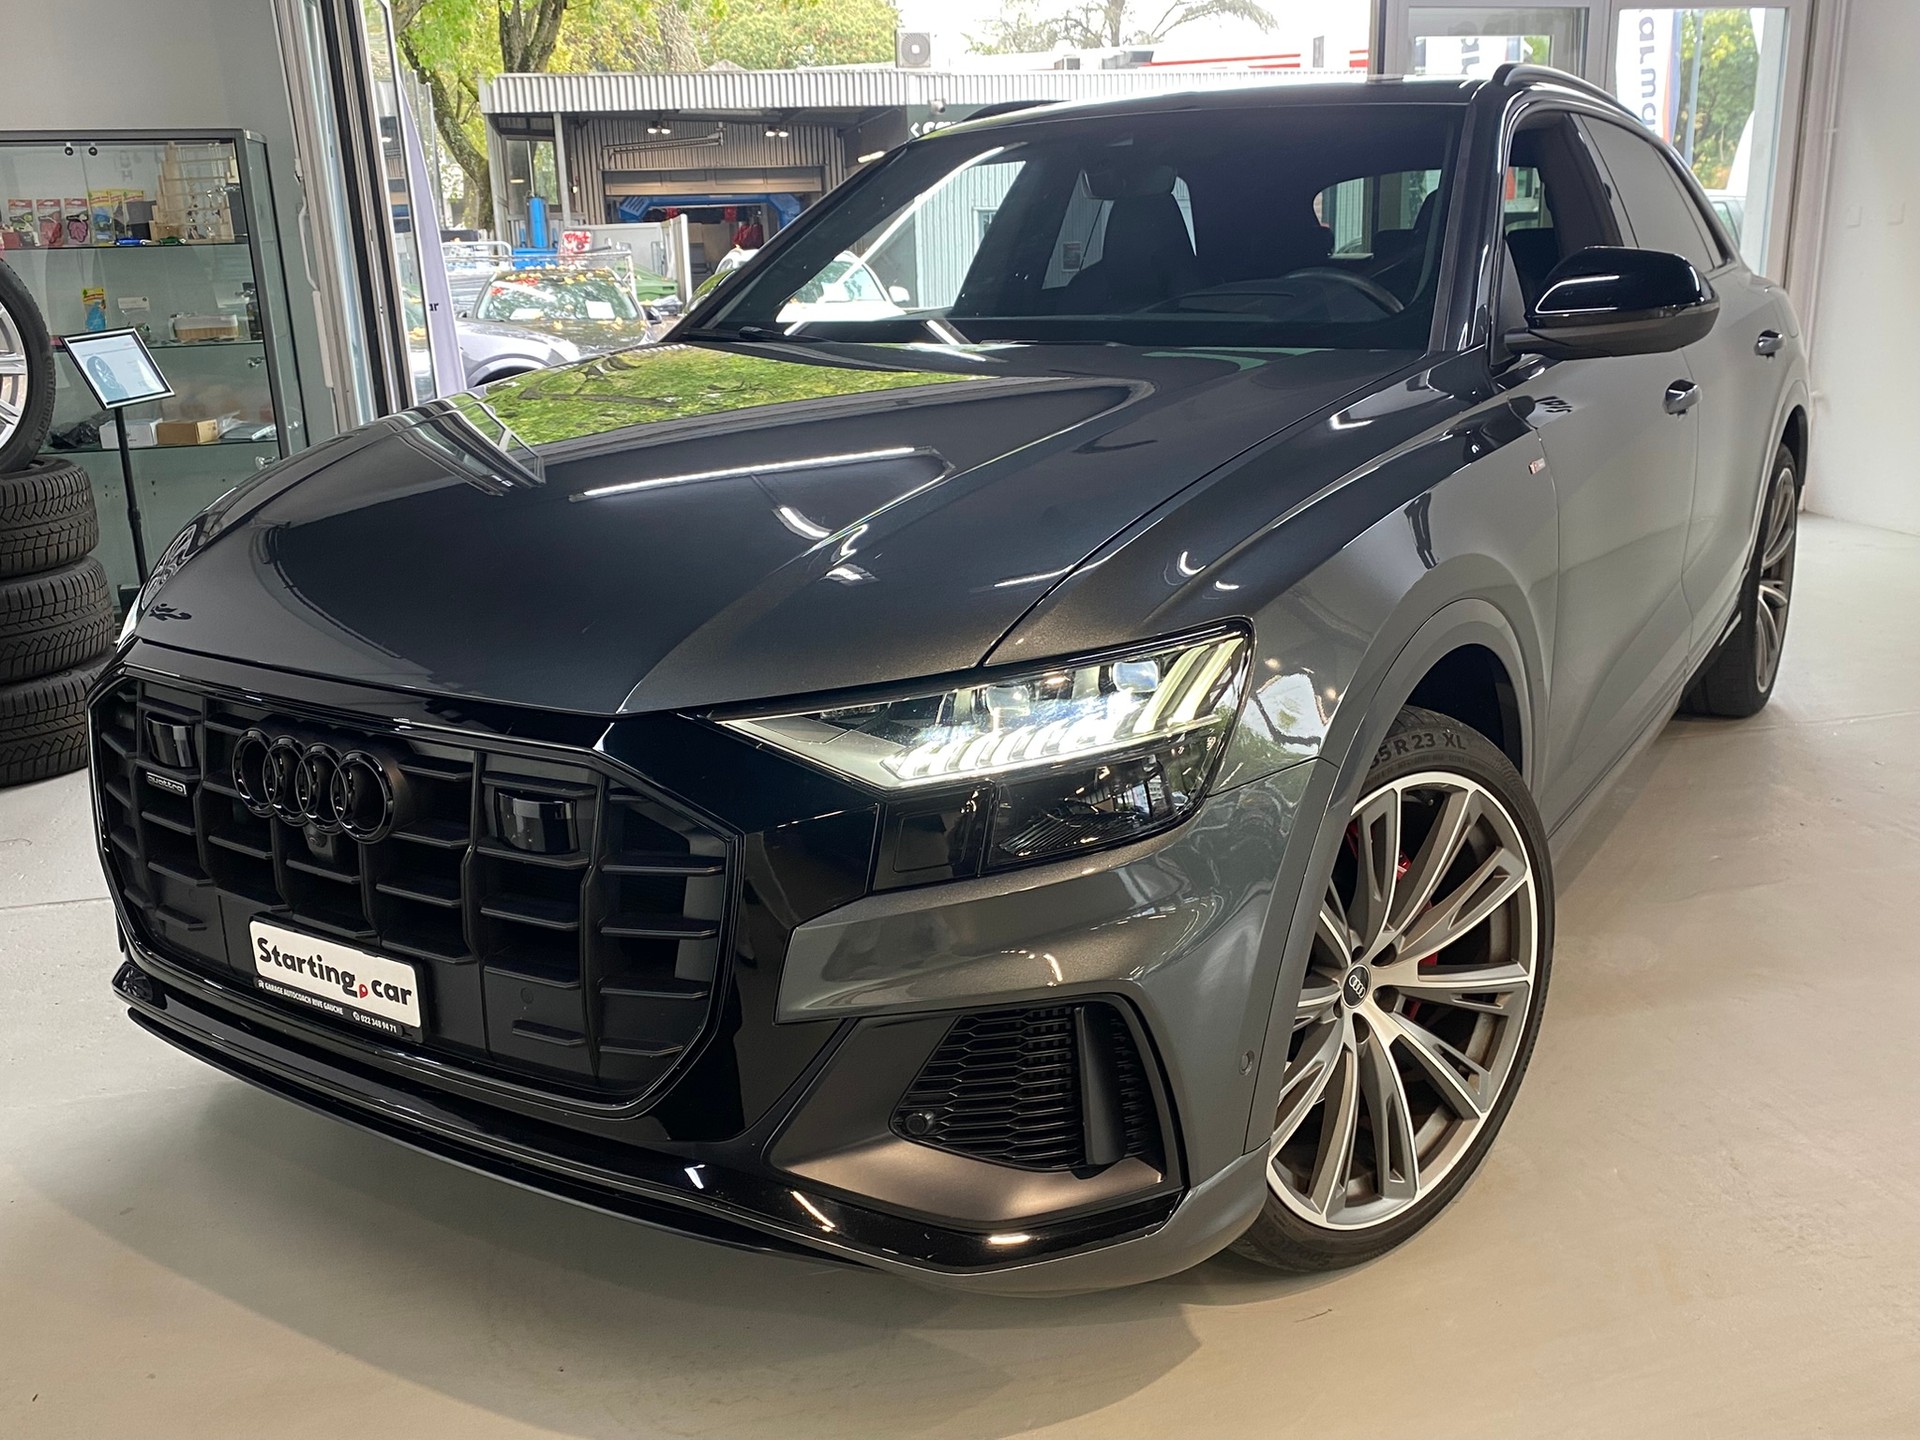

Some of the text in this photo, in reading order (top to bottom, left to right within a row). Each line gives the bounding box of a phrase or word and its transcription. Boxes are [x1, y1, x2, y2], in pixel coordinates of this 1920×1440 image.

[1442, 732, 1467, 750] XL
[147, 774, 184, 793] quattro
[264, 982, 344, 1015] GARAGE AUTOCOACH RIVE GAUCHE
[360, 1014, 371, 1025] 022
[381, 1021, 389, 1031] 94
[389, 1024, 397, 1033] 71
